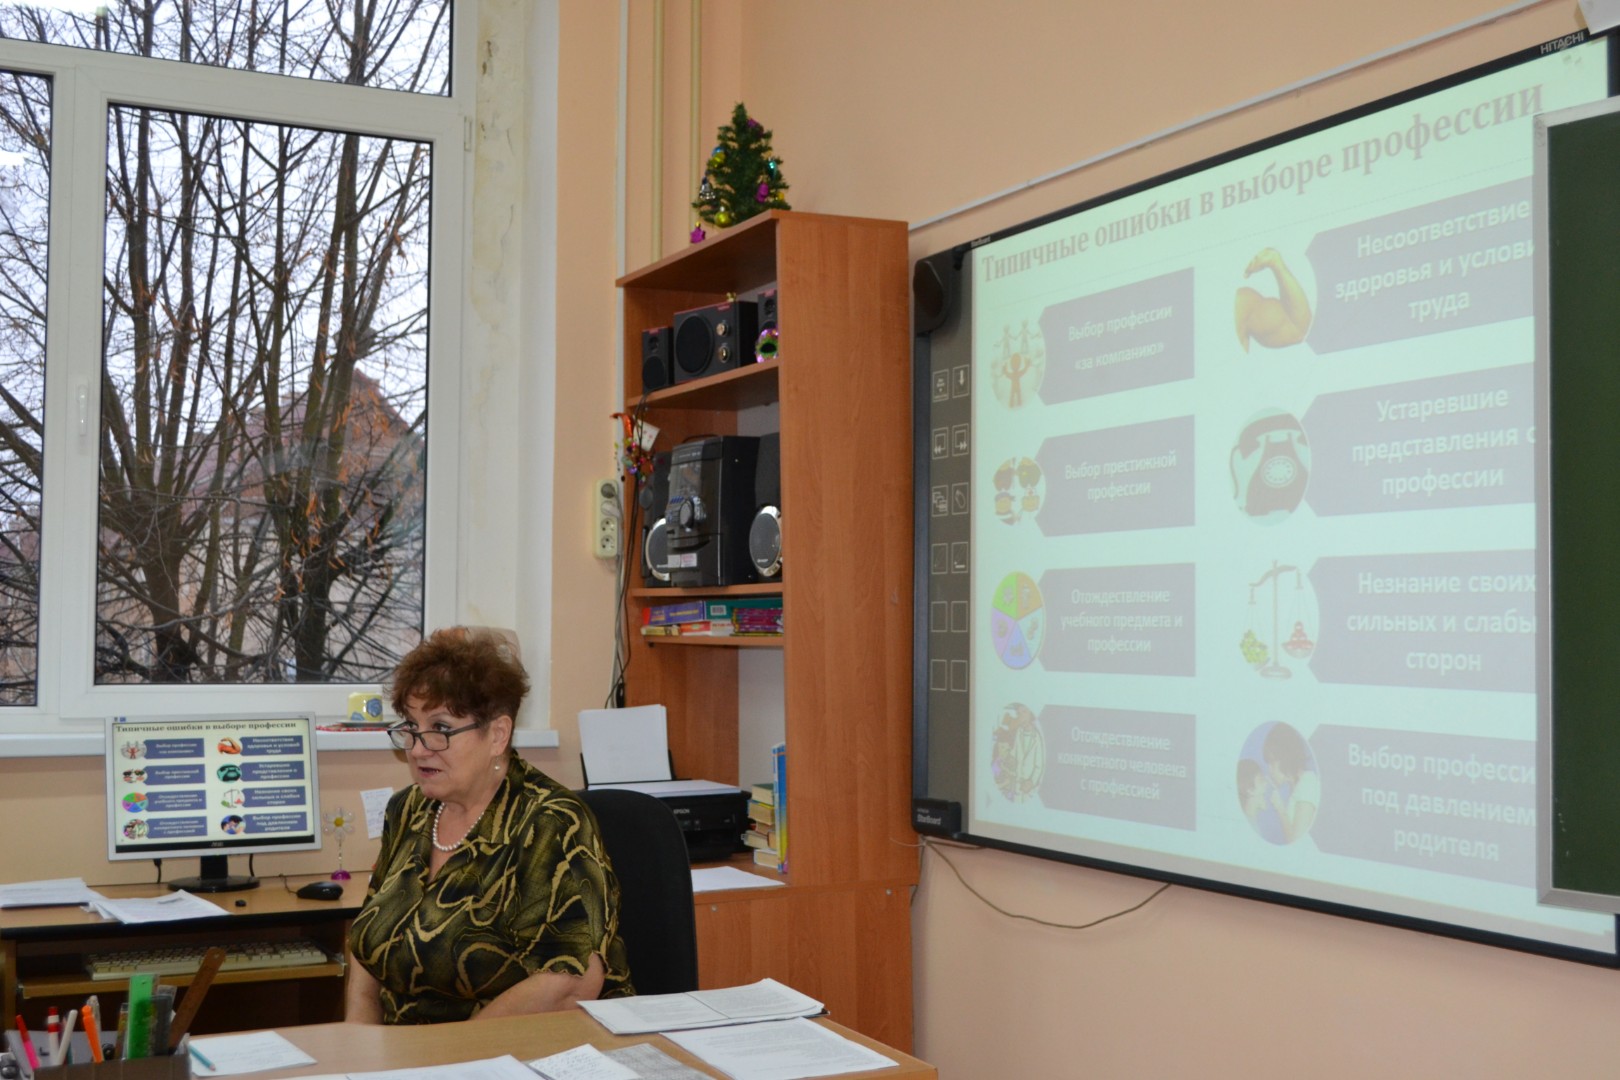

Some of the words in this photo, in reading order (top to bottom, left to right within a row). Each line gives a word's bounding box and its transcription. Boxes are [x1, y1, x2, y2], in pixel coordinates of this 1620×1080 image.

[1540, 31, 1585, 54] HITACHI
[982, 231, 1089, 283] Типичные
[1094, 197, 1192, 247] ошибки
[1199, 191, 1214, 217] в
[1221, 152, 1332, 210] выборе
[1341, 83, 1543, 176] профессии
[1356, 199, 1531, 259] Несоответствие
[1335, 262, 1432, 303] здоровья
[1440, 257, 1452, 276] и
[1408, 291, 1470, 322] труда
[1068, 319, 1104, 342] Выбор
[1107, 305, 1173, 334] профессии
[1376, 389, 1509, 423] Устаревшие
[1352, 427, 1519, 467] представления
[1065, 461, 1100, 481] Выбор
[1103, 450, 1177, 478] престижной
[1087, 480, 1151, 504] профессии
[1382, 468, 1504, 499] профессии
[1071, 588, 1170, 605] Отождествление
[1358, 572, 1461, 594] Незнание
[1468, 574, 1537, 593] своих
[1060, 612, 1111, 631] учебного
[1113, 614, 1172, 631] предмета
[1346, 614, 1437, 632] сильных
[1443, 615, 1456, 632] и
[1087, 634, 1152, 655] профессии
[1406, 651, 1482, 676] сторон
[1071, 726, 1171, 751] Отождествление
[1348, 743, 1416, 777] Выбор
[1088, 778, 1160, 800] профессией
[1361, 787, 1399, 814] под
[1404, 793, 1537, 828] давлением
[1394, 828, 1500, 862] родителя
